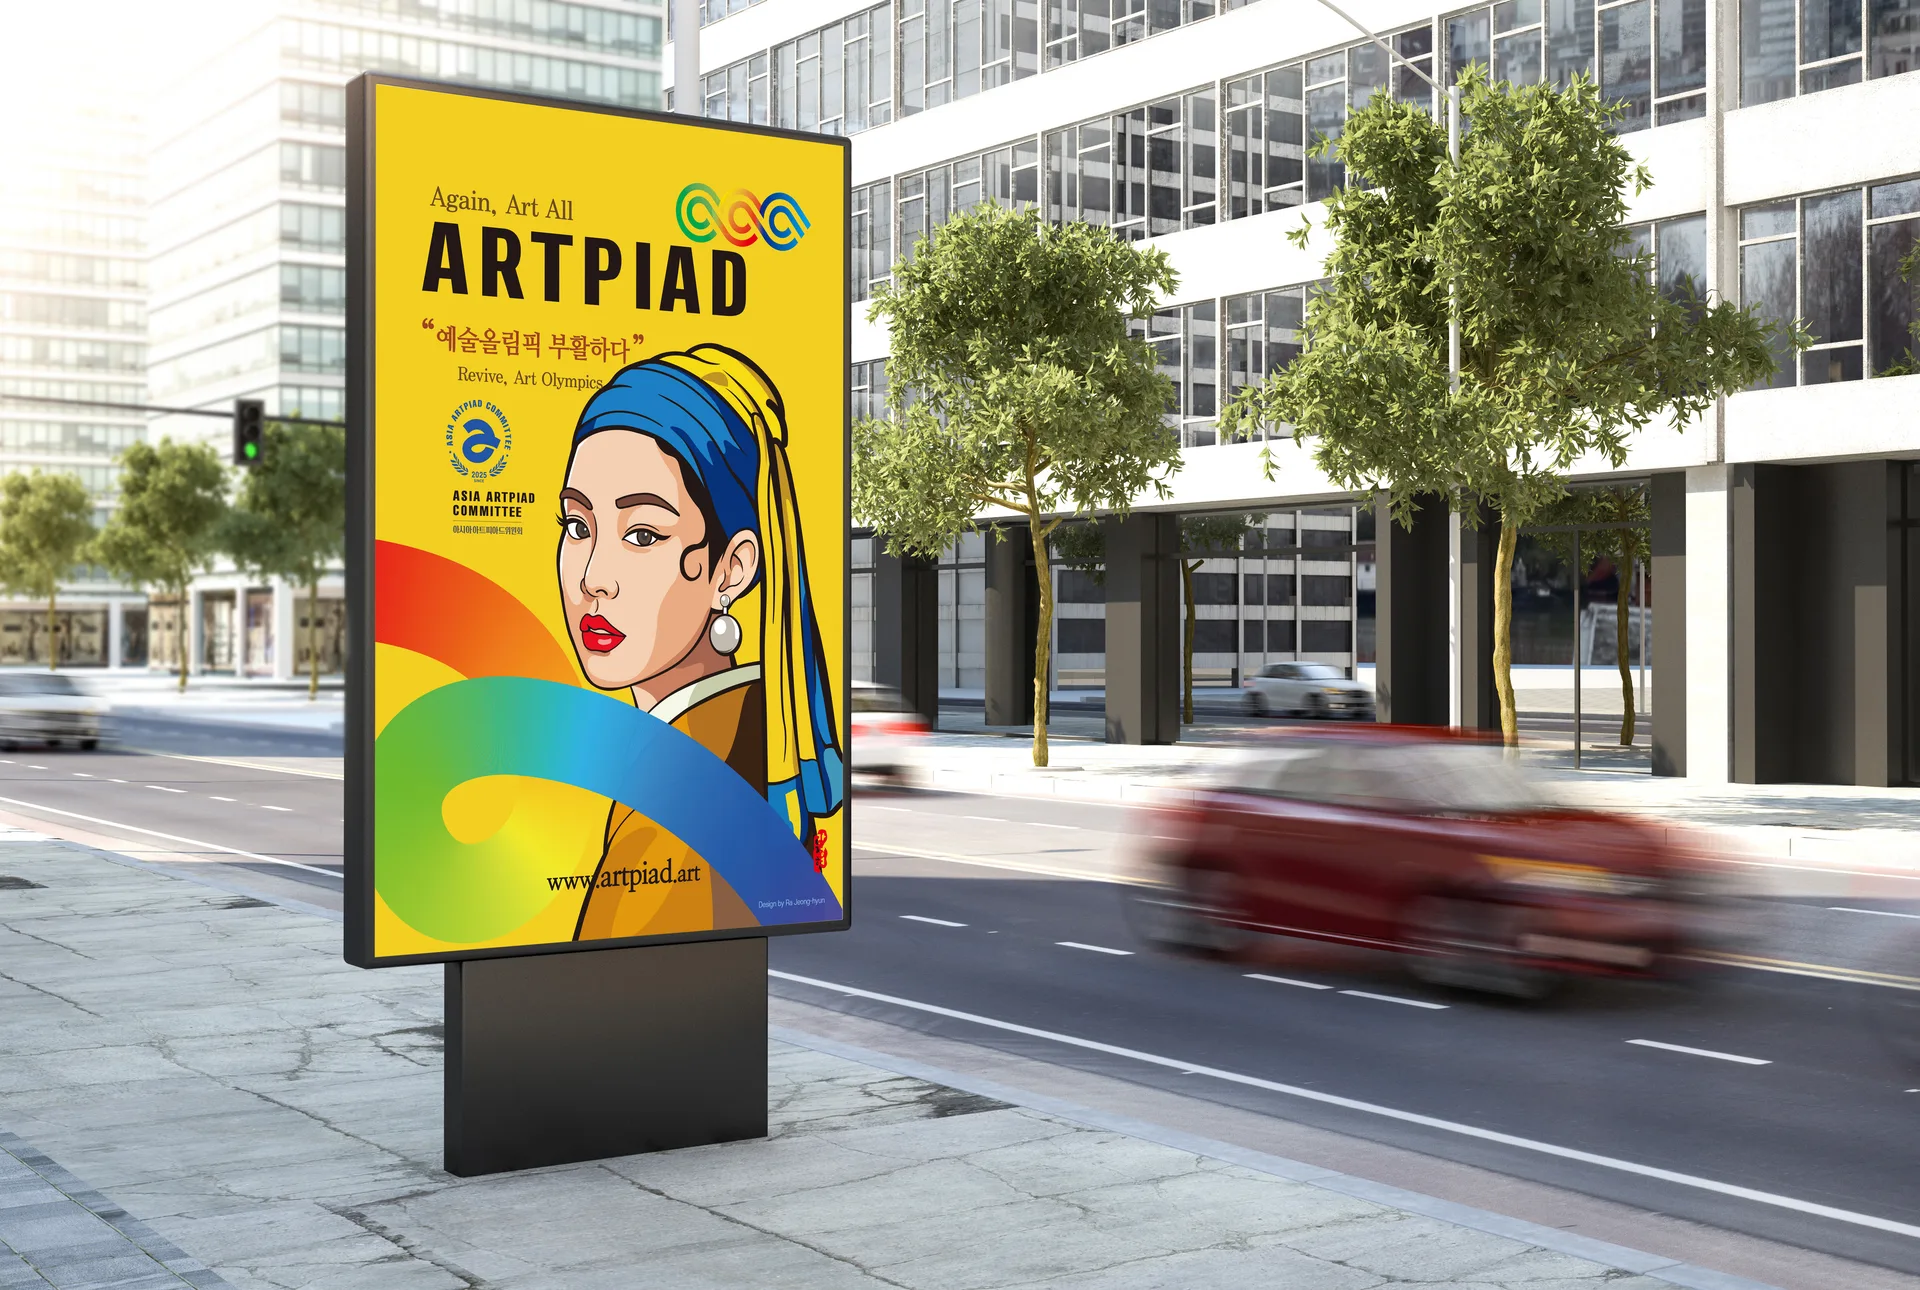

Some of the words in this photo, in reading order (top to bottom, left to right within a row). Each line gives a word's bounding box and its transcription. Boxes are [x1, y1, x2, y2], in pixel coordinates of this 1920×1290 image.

[430, 185, 497, 217] Again,
[505, 193, 540, 218] Art
[545, 198, 574, 221] All
[422, 221, 747, 317] ARTPIAD
[457, 366, 508, 387] Revive,
[513, 370, 538, 386] Art
[541, 371, 604, 392] Olympics
[445, 424, 455, 447] ASIA
[451, 399, 483, 422] ARTPIAD
[485, 401, 512, 451] COMMITTEE
[471, 471, 487, 479] 2025
[453, 490, 481, 502] ASIA
[486, 491, 535, 504] ARTPIAD
[453, 504, 522, 518] COMMITTEE
[547, 857, 701, 893] www.artpiad.art
[758, 900, 777, 909] Design
[777, 899, 785, 908] by
